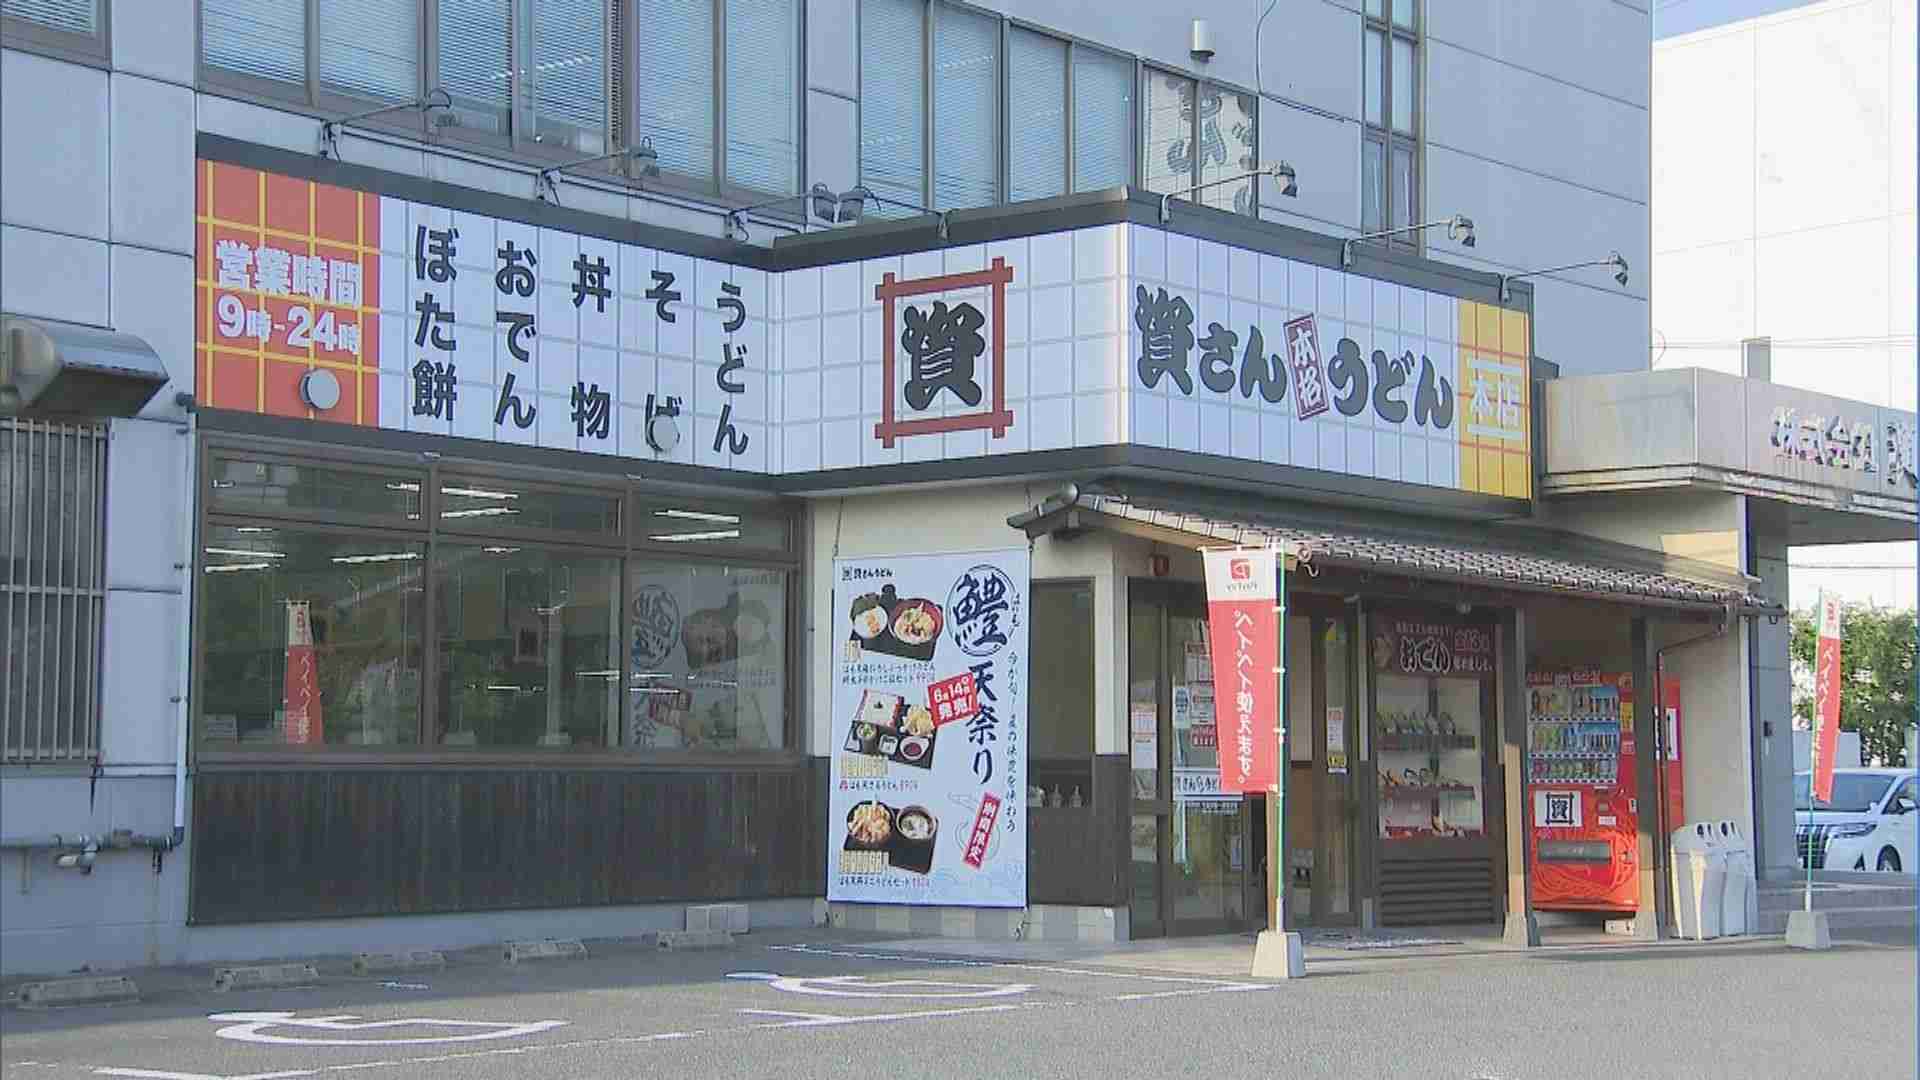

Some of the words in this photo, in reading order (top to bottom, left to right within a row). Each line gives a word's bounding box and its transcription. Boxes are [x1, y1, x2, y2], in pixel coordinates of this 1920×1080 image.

[215, 239, 363, 306] 営業時間
[412, 223, 460, 421] ぼた餅
[494, 239, 538, 429] おでん
[571, 253, 613, 440] 丼物
[713, 281, 749, 456] うどん
[901, 300, 985, 411] 資
[1134, 283, 1288, 404] 資さん
[1290, 326, 1322, 409] 本格
[1327, 337, 1455, 430] うどん
[1470, 377, 1521, 427] 本店
